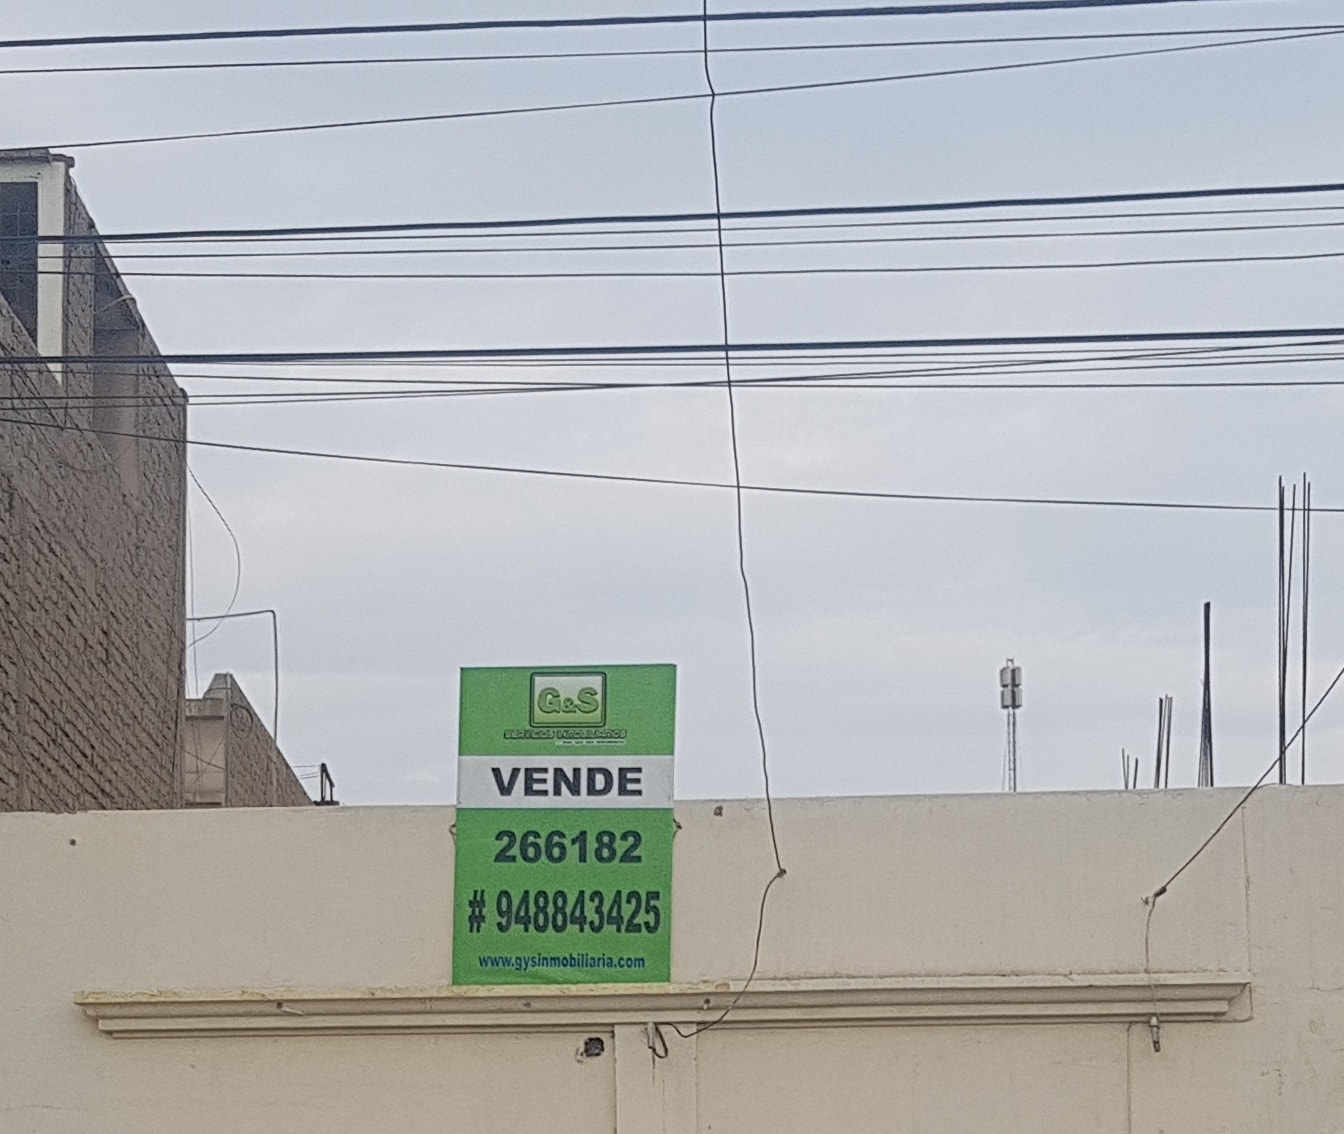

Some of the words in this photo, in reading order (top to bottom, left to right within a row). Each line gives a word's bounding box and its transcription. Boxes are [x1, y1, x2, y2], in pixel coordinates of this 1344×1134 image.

[537, 686, 600, 714] G&S
[490, 766, 644, 797] VENDE
[493, 829, 643, 864] 266182
[495, 888, 661, 934] 948843425
[477, 953, 646, 972] www.gysinmobiliaria.com
